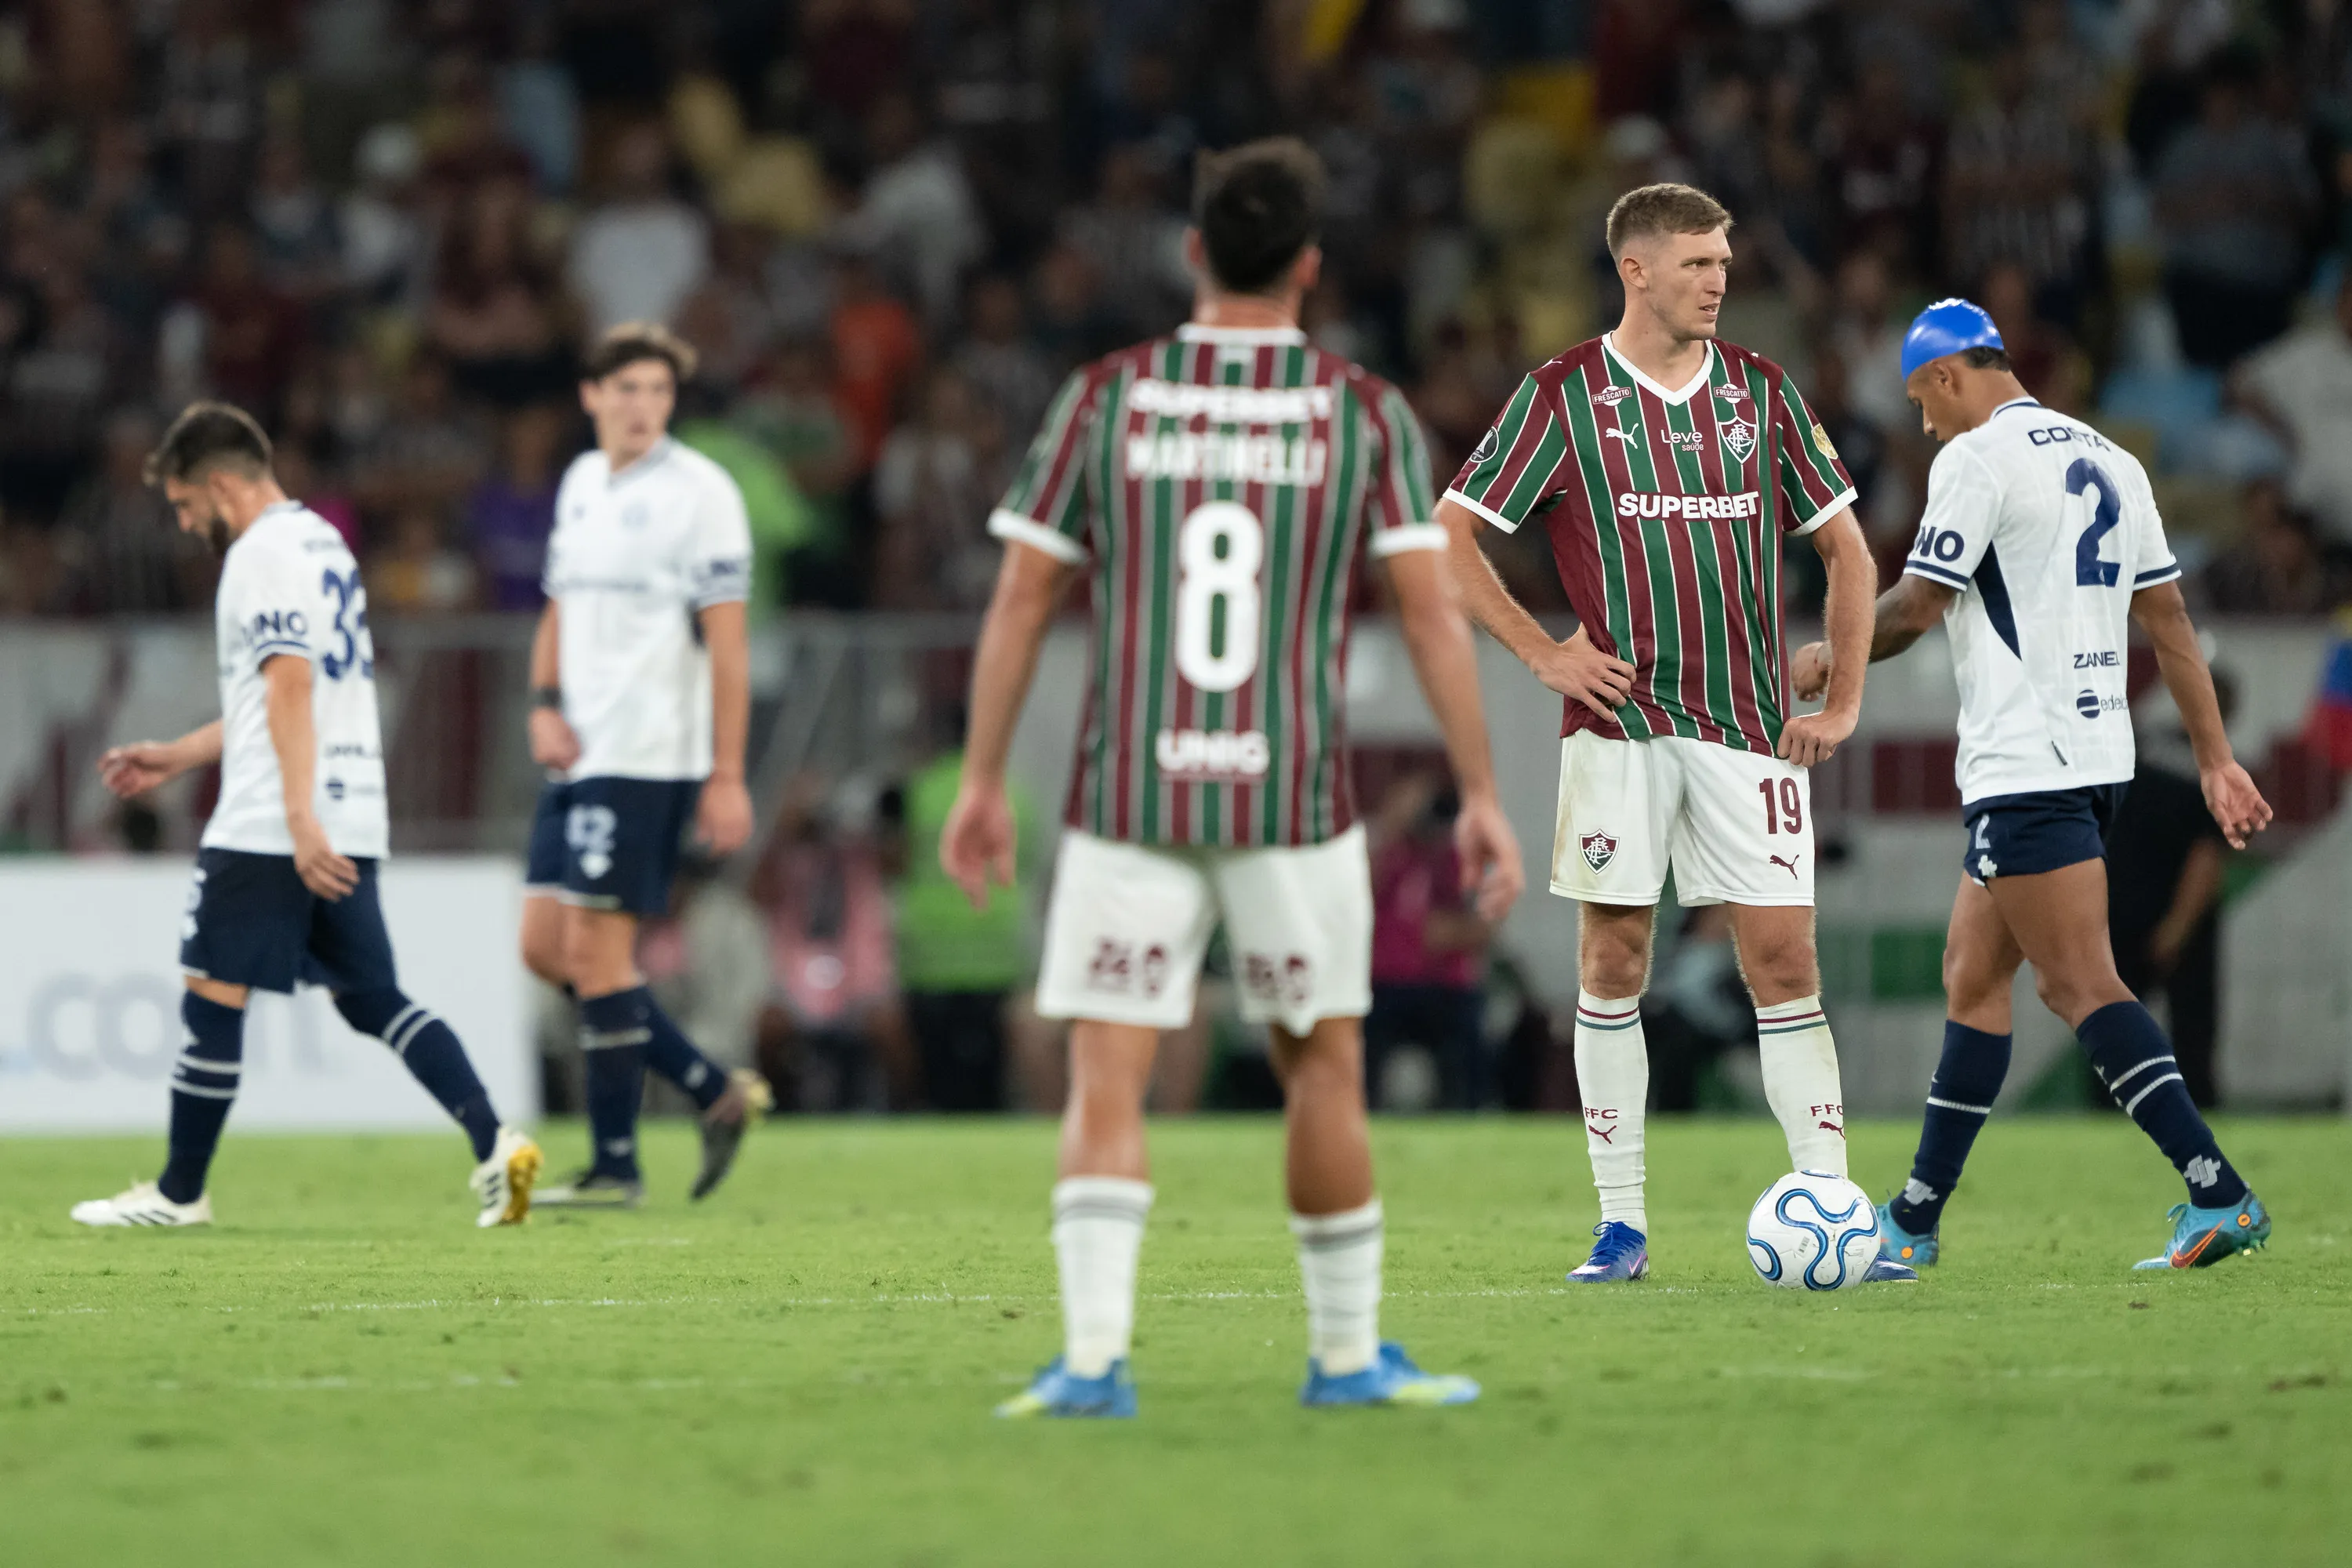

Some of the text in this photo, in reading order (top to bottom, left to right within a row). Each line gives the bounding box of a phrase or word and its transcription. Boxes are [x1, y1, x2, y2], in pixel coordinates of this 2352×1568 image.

[1594, 389, 1631, 404] FRESCATTO
[1715, 388, 1748, 397] FRESCATTO
[1661, 429, 1703, 444] Leve
[1681, 441, 1704, 452] saúde
[1617, 491, 1760, 519] SUPERBET
[2065, 457, 2122, 588] 2
[1176, 500, 1264, 691] 8
[1759, 777, 1802, 835] 19
[1584, 1106, 1618, 1120] FFC
